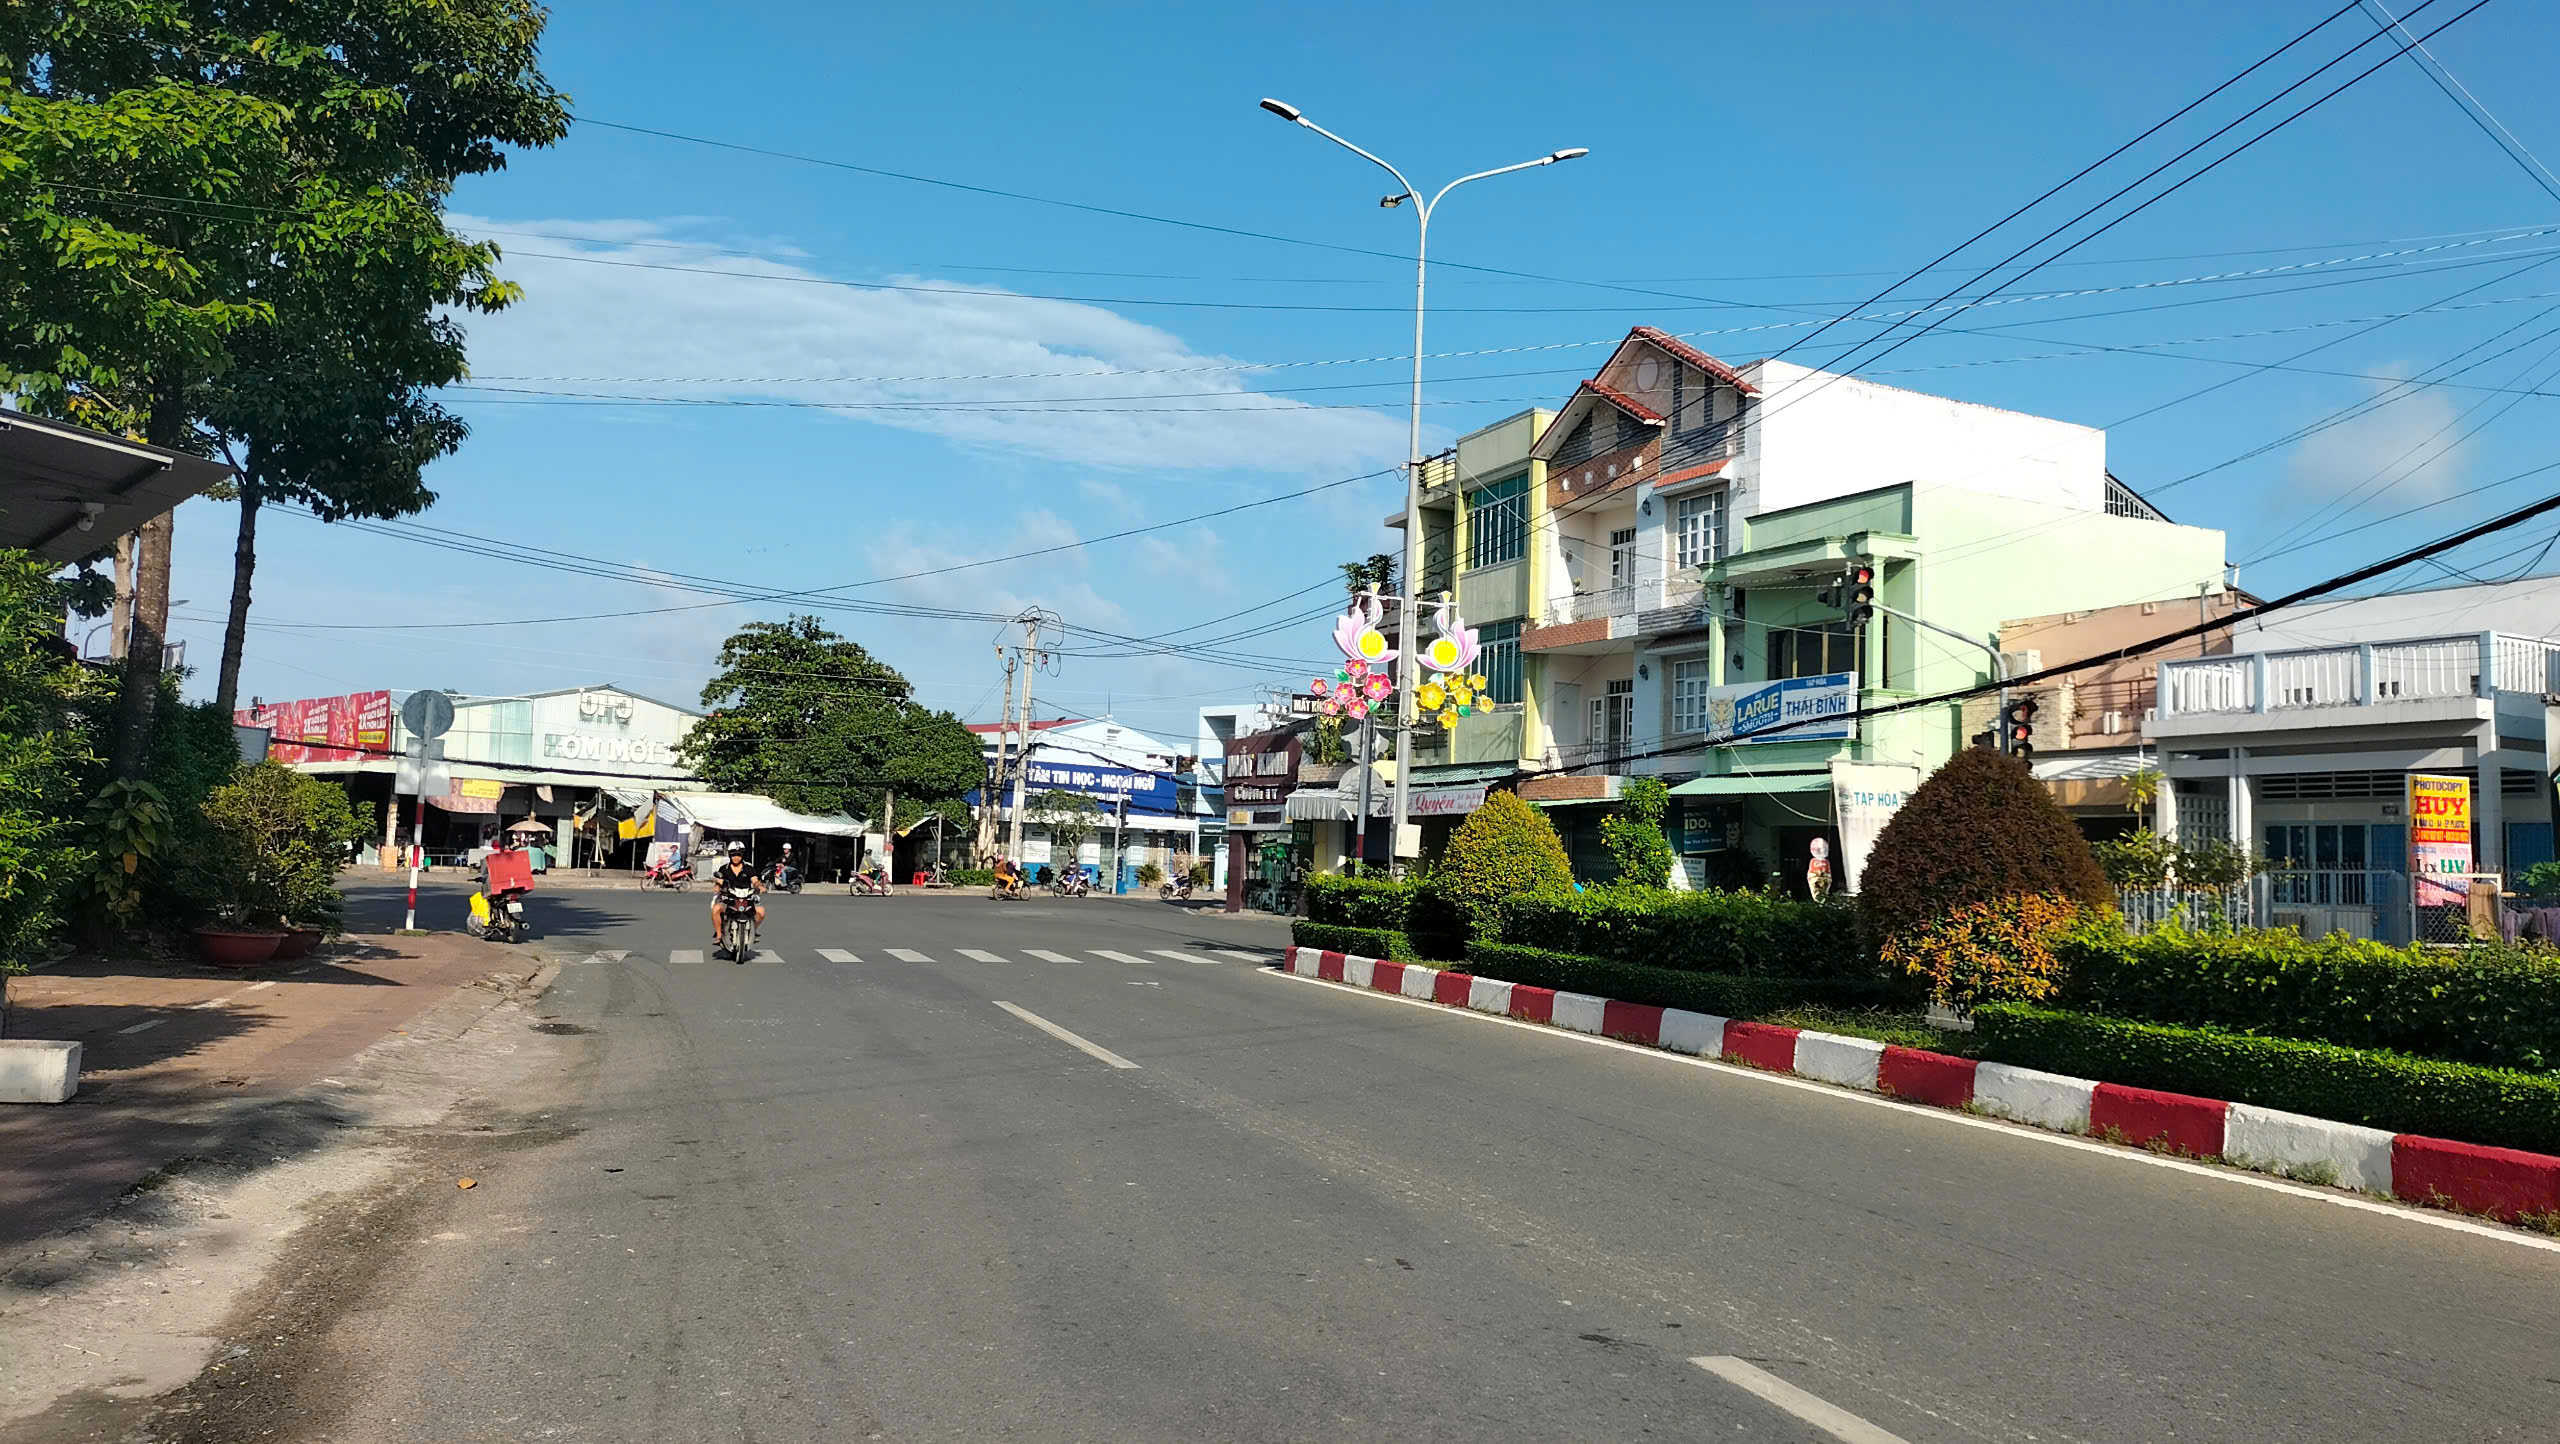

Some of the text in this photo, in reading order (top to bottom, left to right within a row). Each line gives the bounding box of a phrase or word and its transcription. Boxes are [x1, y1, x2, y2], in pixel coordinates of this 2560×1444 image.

[1294, 697, 1310, 711] MẮT
[1737, 692, 1780, 723] LARUE
[1786, 696, 1813, 716] THÁI
[1051, 769, 1070, 785] TIN
[1072, 771, 1095, 789] HỌC
[2413, 780, 2463, 793] PHOTOCOPY
[1415, 793, 1455, 813] Quyên
[2415, 795, 2467, 816] HUY
